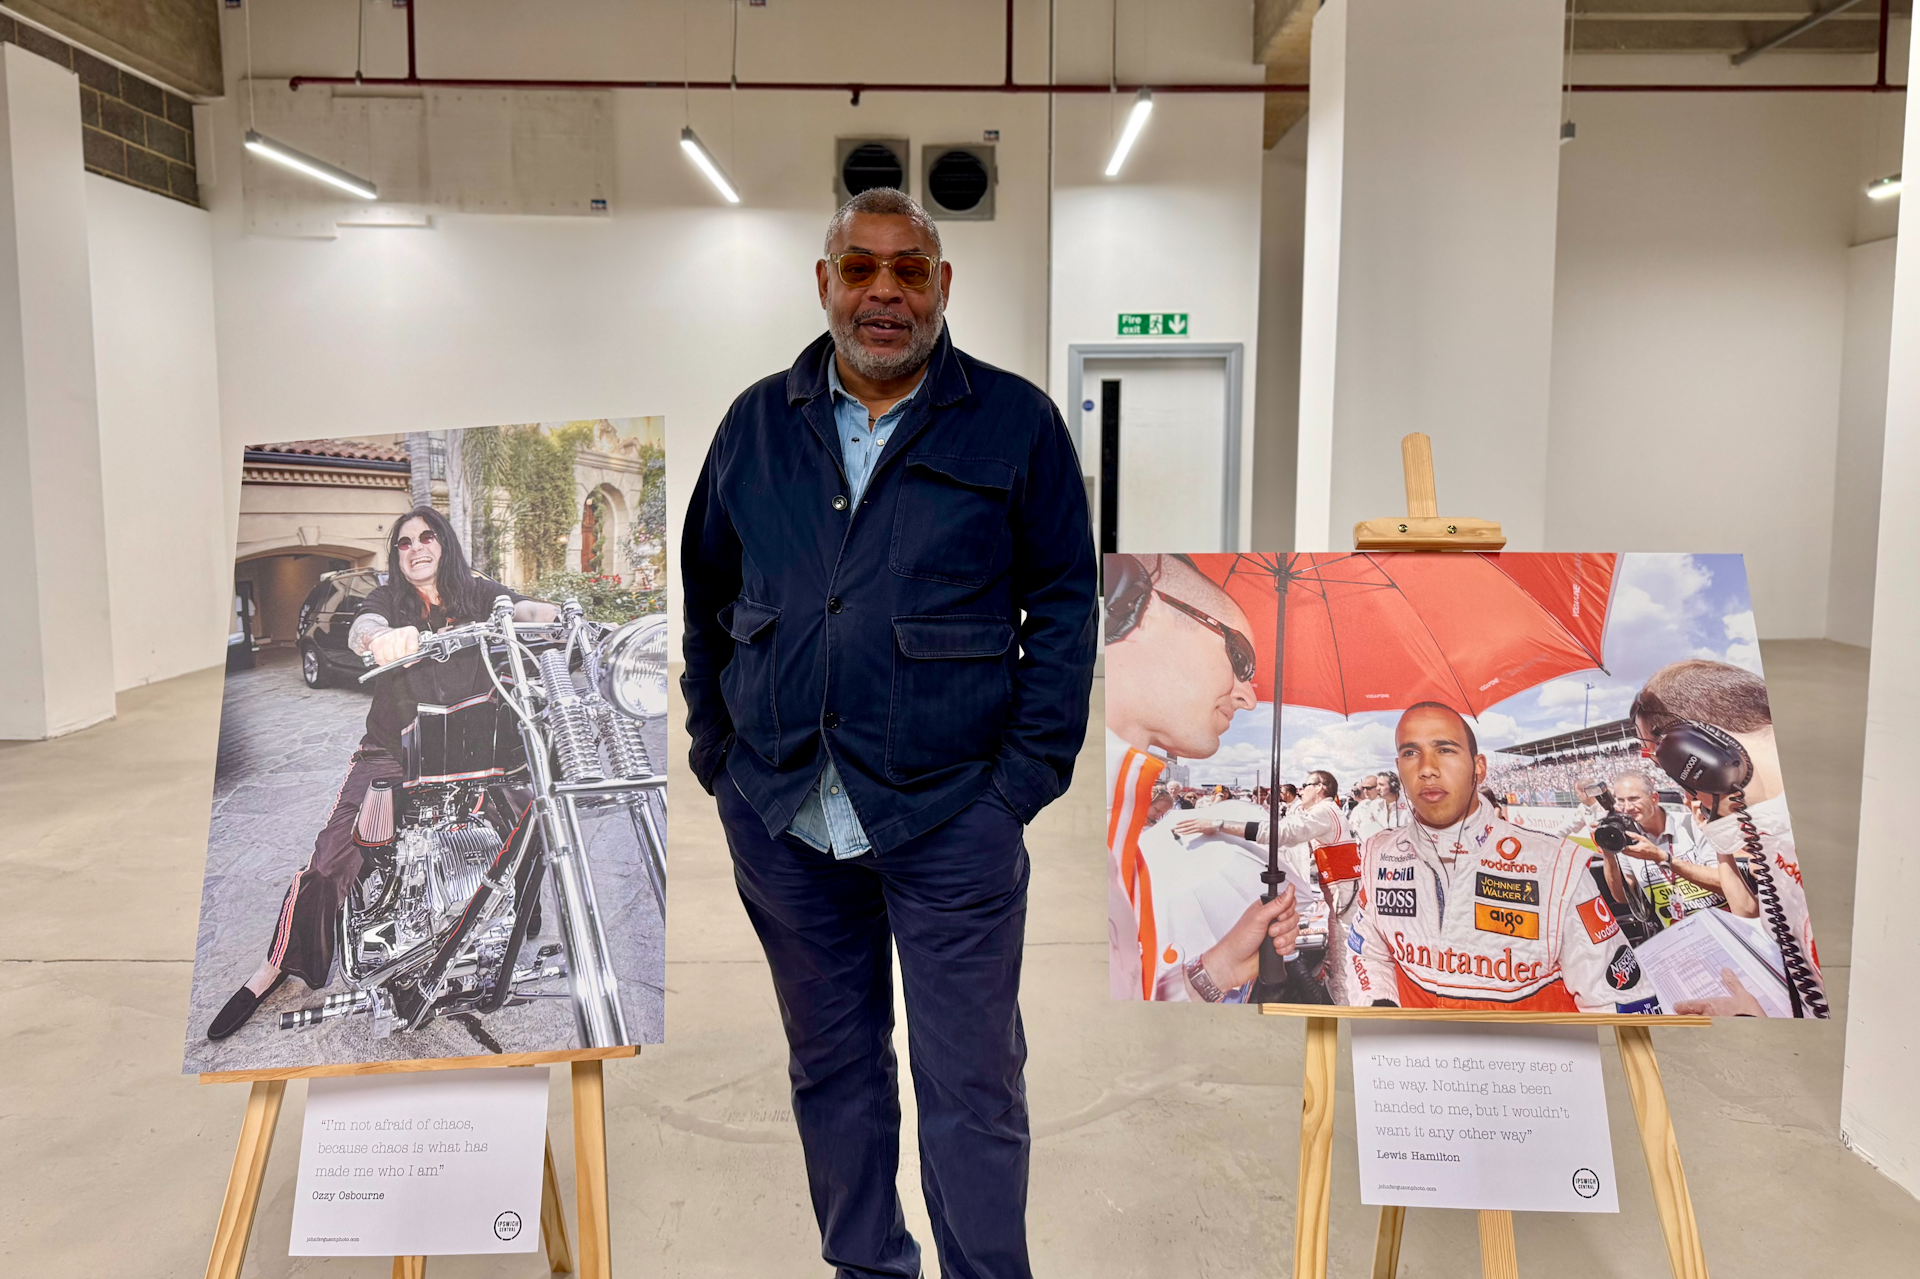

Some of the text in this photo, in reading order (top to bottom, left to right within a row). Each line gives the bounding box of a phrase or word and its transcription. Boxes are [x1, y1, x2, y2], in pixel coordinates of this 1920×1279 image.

[1122, 315, 1142, 324] Fire
[1122, 325, 1141, 334] exit
[1480, 859, 1538, 874] vodafone
[1377, 867, 1406, 881] Mobil
[1481, 877, 1521, 892] JOHNNIE
[1377, 890, 1415, 908] BOSS
[1482, 886, 1521, 900] WALKER
[1490, 908, 1524, 934] aigo
[1394, 931, 1542, 983] Santander
[1405, 1056, 1431, 1068] had
[1435, 1057, 1448, 1069] to
[1453, 1057, 1485, 1072] fight
[1488, 1061, 1525, 1073] every
[1529, 1059, 1556, 1074] step
[1560, 1060, 1574, 1073] of
[1372, 1078, 1552, 1095] the way. Nothing has been
[1374, 1101, 1425, 1114] handed
[1430, 1103, 1443, 1115] to
[1447, 1105, 1473, 1118] me,
[1476, 1104, 1499, 1117] but
[1502, 1105, 1508, 1117] I
[350, 1120, 371, 1131] not
[374, 1118, 413, 1131] afraid
[416, 1118, 432, 1131] of
[433, 1118, 474, 1132] chaos,
[1375, 1126, 1410, 1137] want
[1414, 1125, 1425, 1138] it
[1428, 1128, 1454, 1141] any
[1459, 1127, 1496, 1140] other
[318, 1141, 488, 1154] because chaos is what has
[1377, 1150, 1460, 1162] Lewis Hamilton
[315, 1165, 350, 1177] made
[353, 1167, 374, 1177] me
[378, 1165, 405, 1177] who
[408, 1165, 414, 1176] I
[312, 1190, 385, 1201] Ozzy Osbourne
